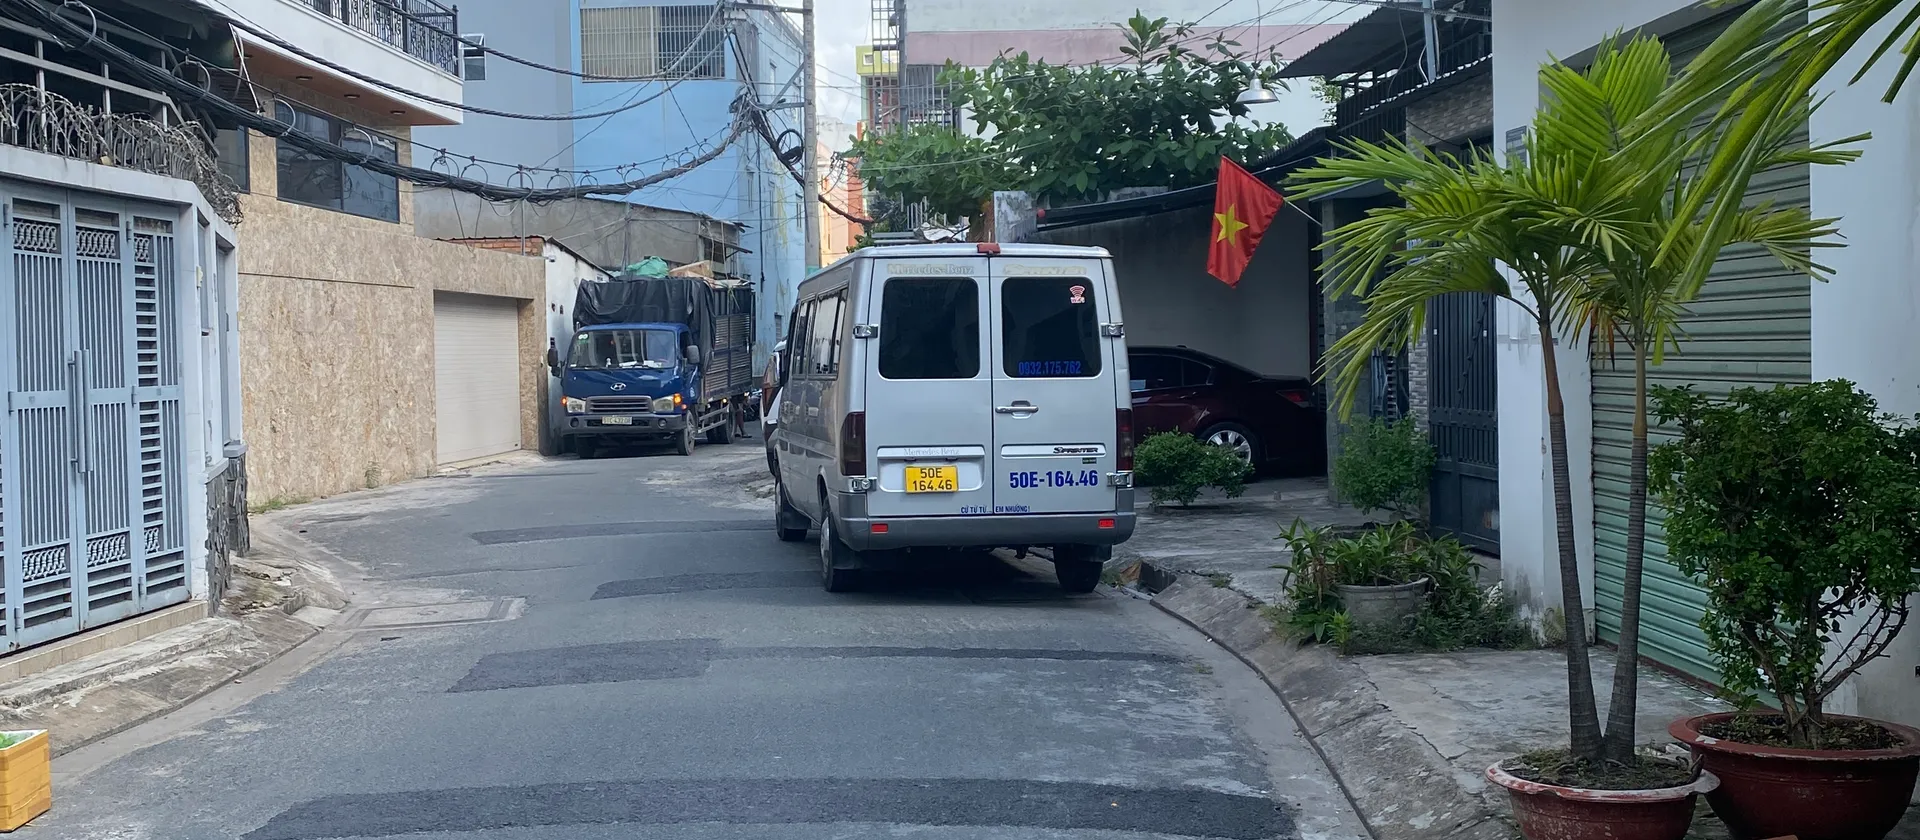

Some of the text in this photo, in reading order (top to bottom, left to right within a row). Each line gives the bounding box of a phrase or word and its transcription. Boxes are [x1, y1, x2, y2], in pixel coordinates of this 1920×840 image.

[887, 263, 975, 275] Mercedes-Benz
[1018, 361, 1081, 375] 0932.175.762
[920, 467, 943, 479] 50E
[1009, 469, 1099, 488] 50E-164.46
[912, 479, 953, 491] 164.46
